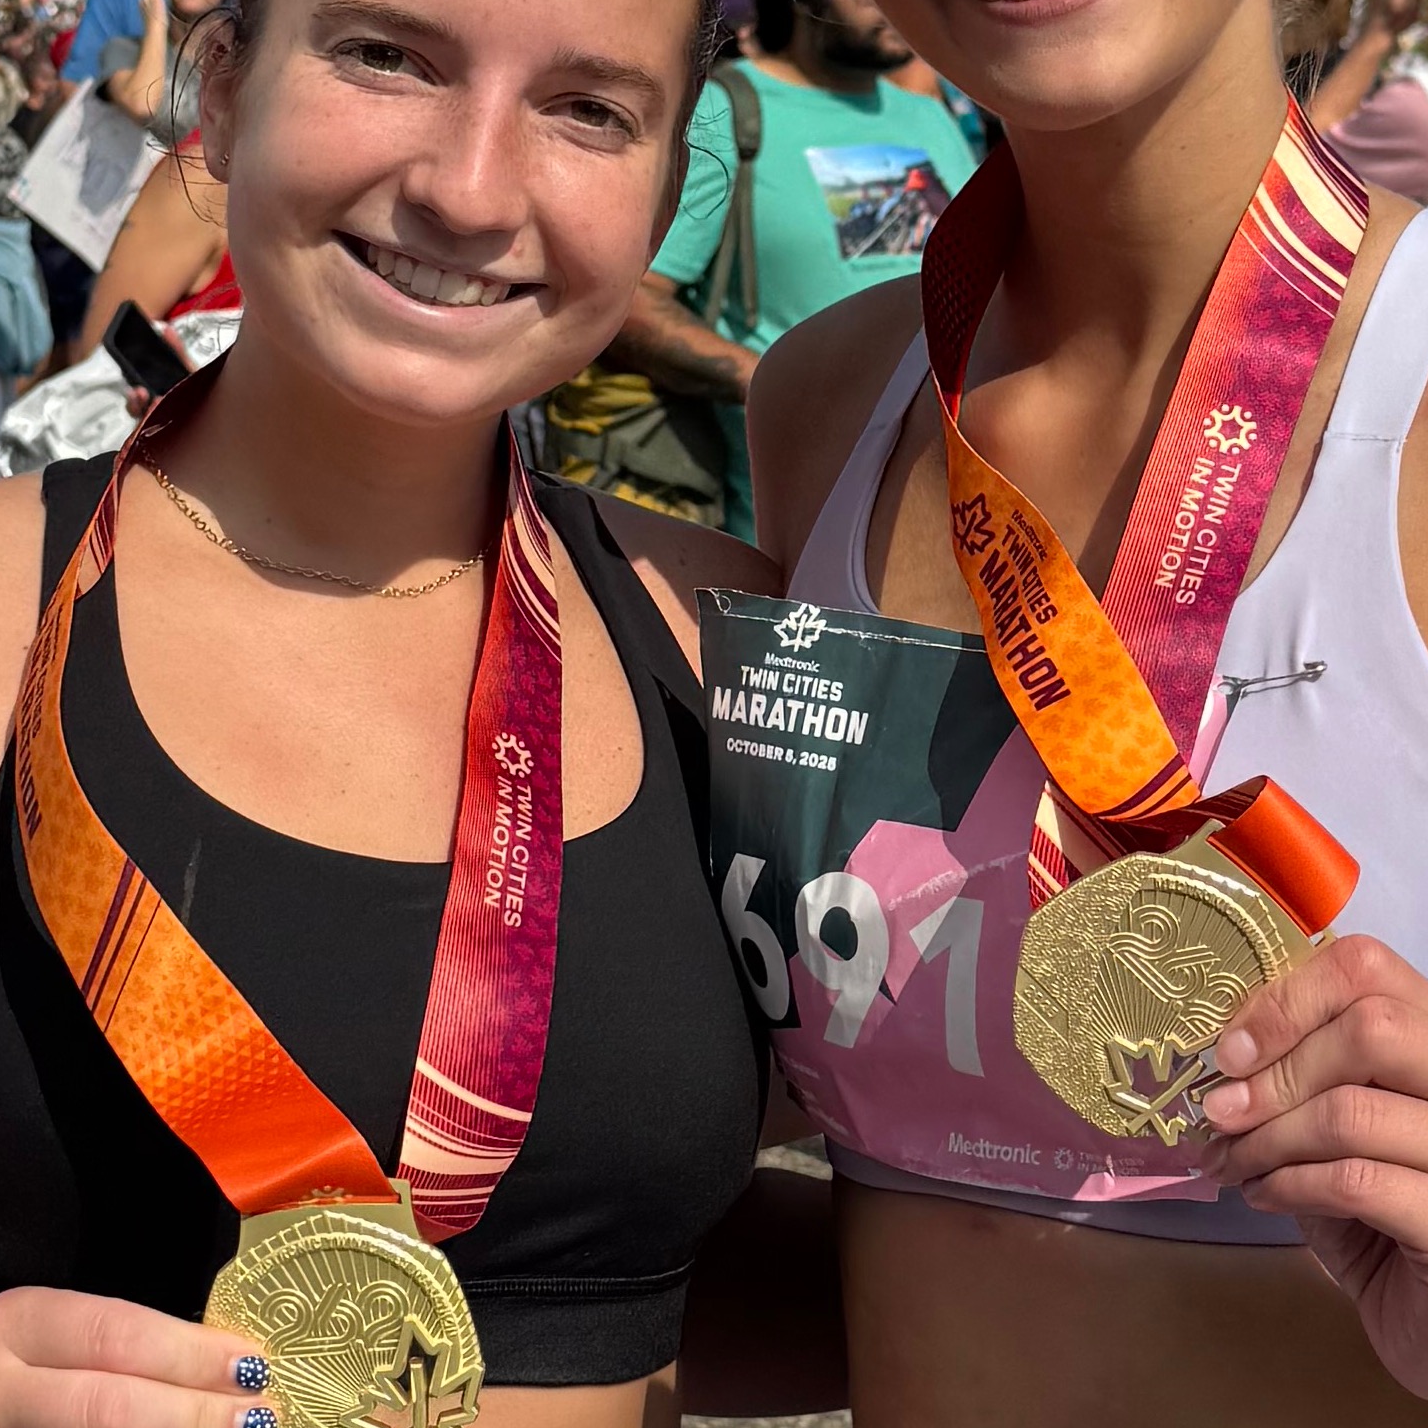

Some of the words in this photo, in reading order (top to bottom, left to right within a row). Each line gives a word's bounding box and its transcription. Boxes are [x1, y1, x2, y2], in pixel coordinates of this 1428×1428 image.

[1190, 456, 1215, 485] IN
[1204, 463, 1242, 525] TWIN
[1154, 487, 1204, 589] MOTION
[1176, 528, 1217, 605] CITIES
[1001, 524, 1034, 576] TWIN
[1023, 565, 1058, 625] CITIES
[979, 548, 1071, 711] MARATHON
[740, 665, 780, 691] TWIN
[782, 673, 843, 702] CITIES
[712, 686, 869, 745] MARATHON
[726, 737, 785, 762] OCTOBER
[497, 775, 513, 801] IN
[516, 785, 533, 841] TWIN
[484, 802, 513, 909] MOTION
[503, 844, 530, 928] CITIES
[948, 1132, 1041, 1165] Medtronic
